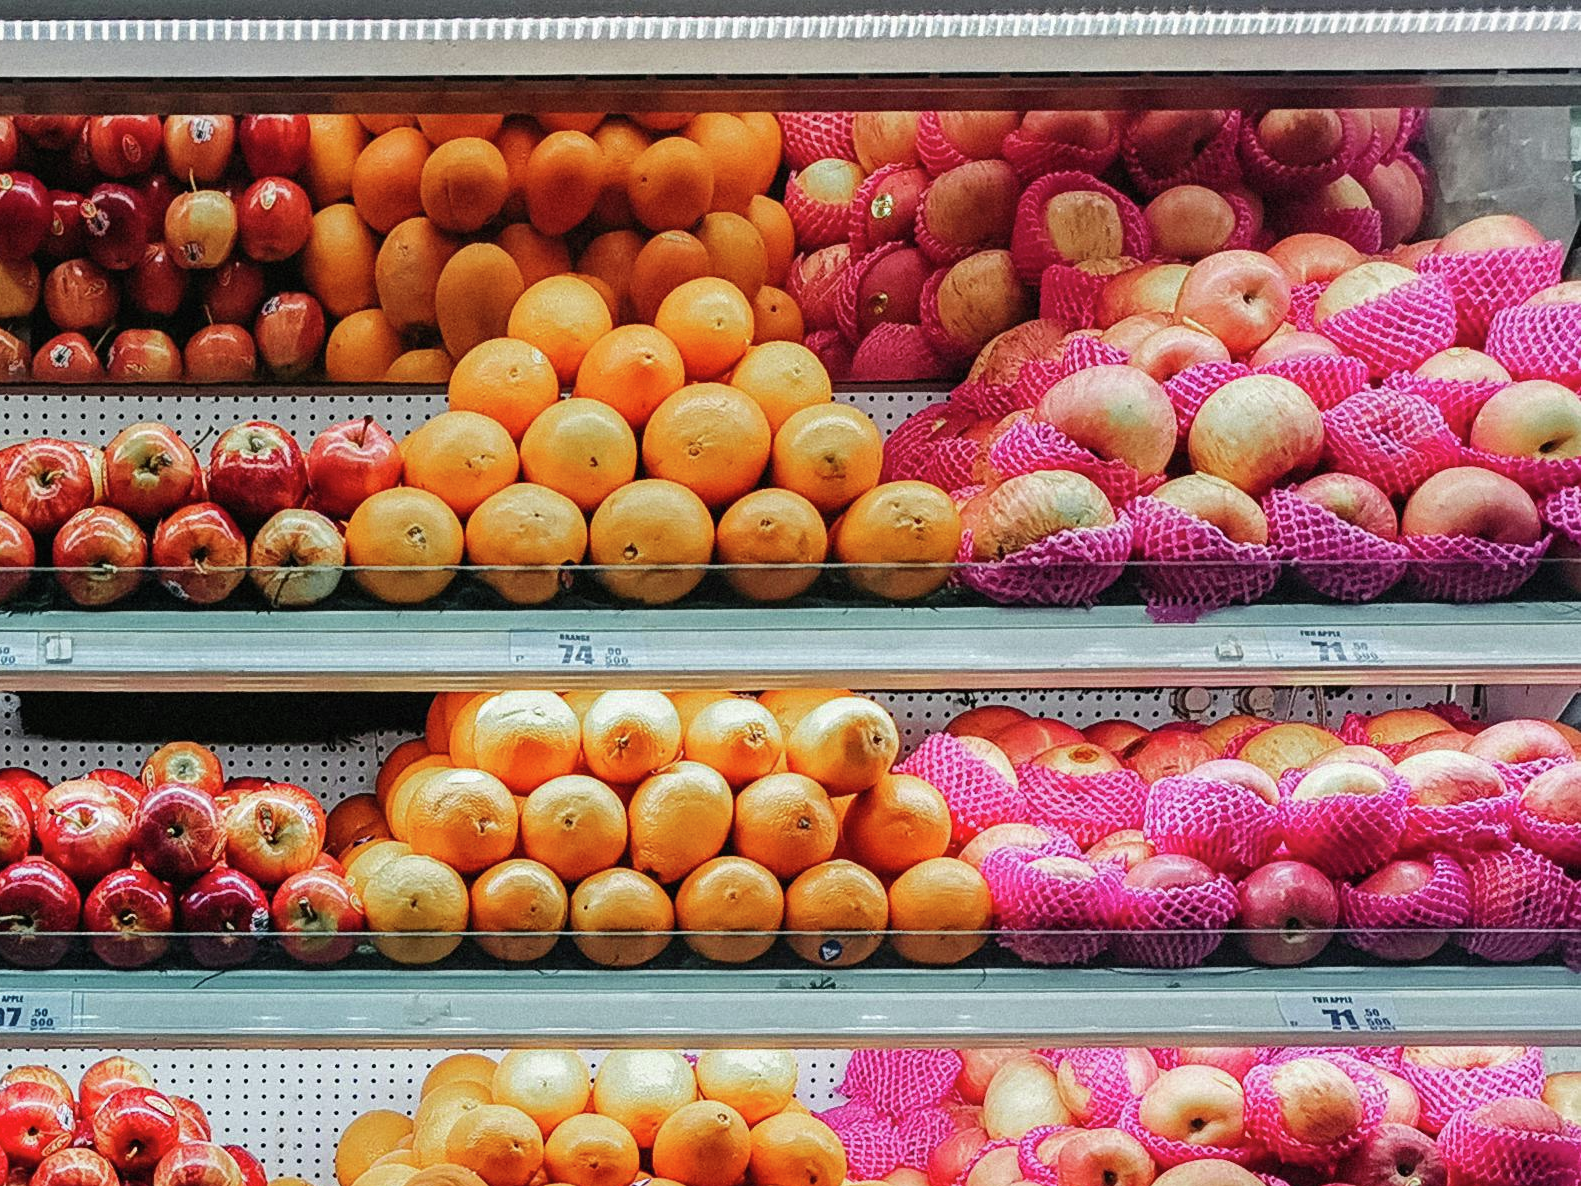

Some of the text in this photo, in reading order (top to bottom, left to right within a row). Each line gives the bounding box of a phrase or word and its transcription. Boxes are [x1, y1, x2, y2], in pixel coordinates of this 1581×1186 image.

[559, 634, 590, 642] ORANGE
[558, 644, 594, 665] 74
[1311, 641, 1347, 662] 71
[1, 995, 24, 1003] APPLE
[1330, 996, 1353, 1004] APPLE
[30, 1018, 53, 1027] 500
[1321, 1008, 1360, 1030] 71
